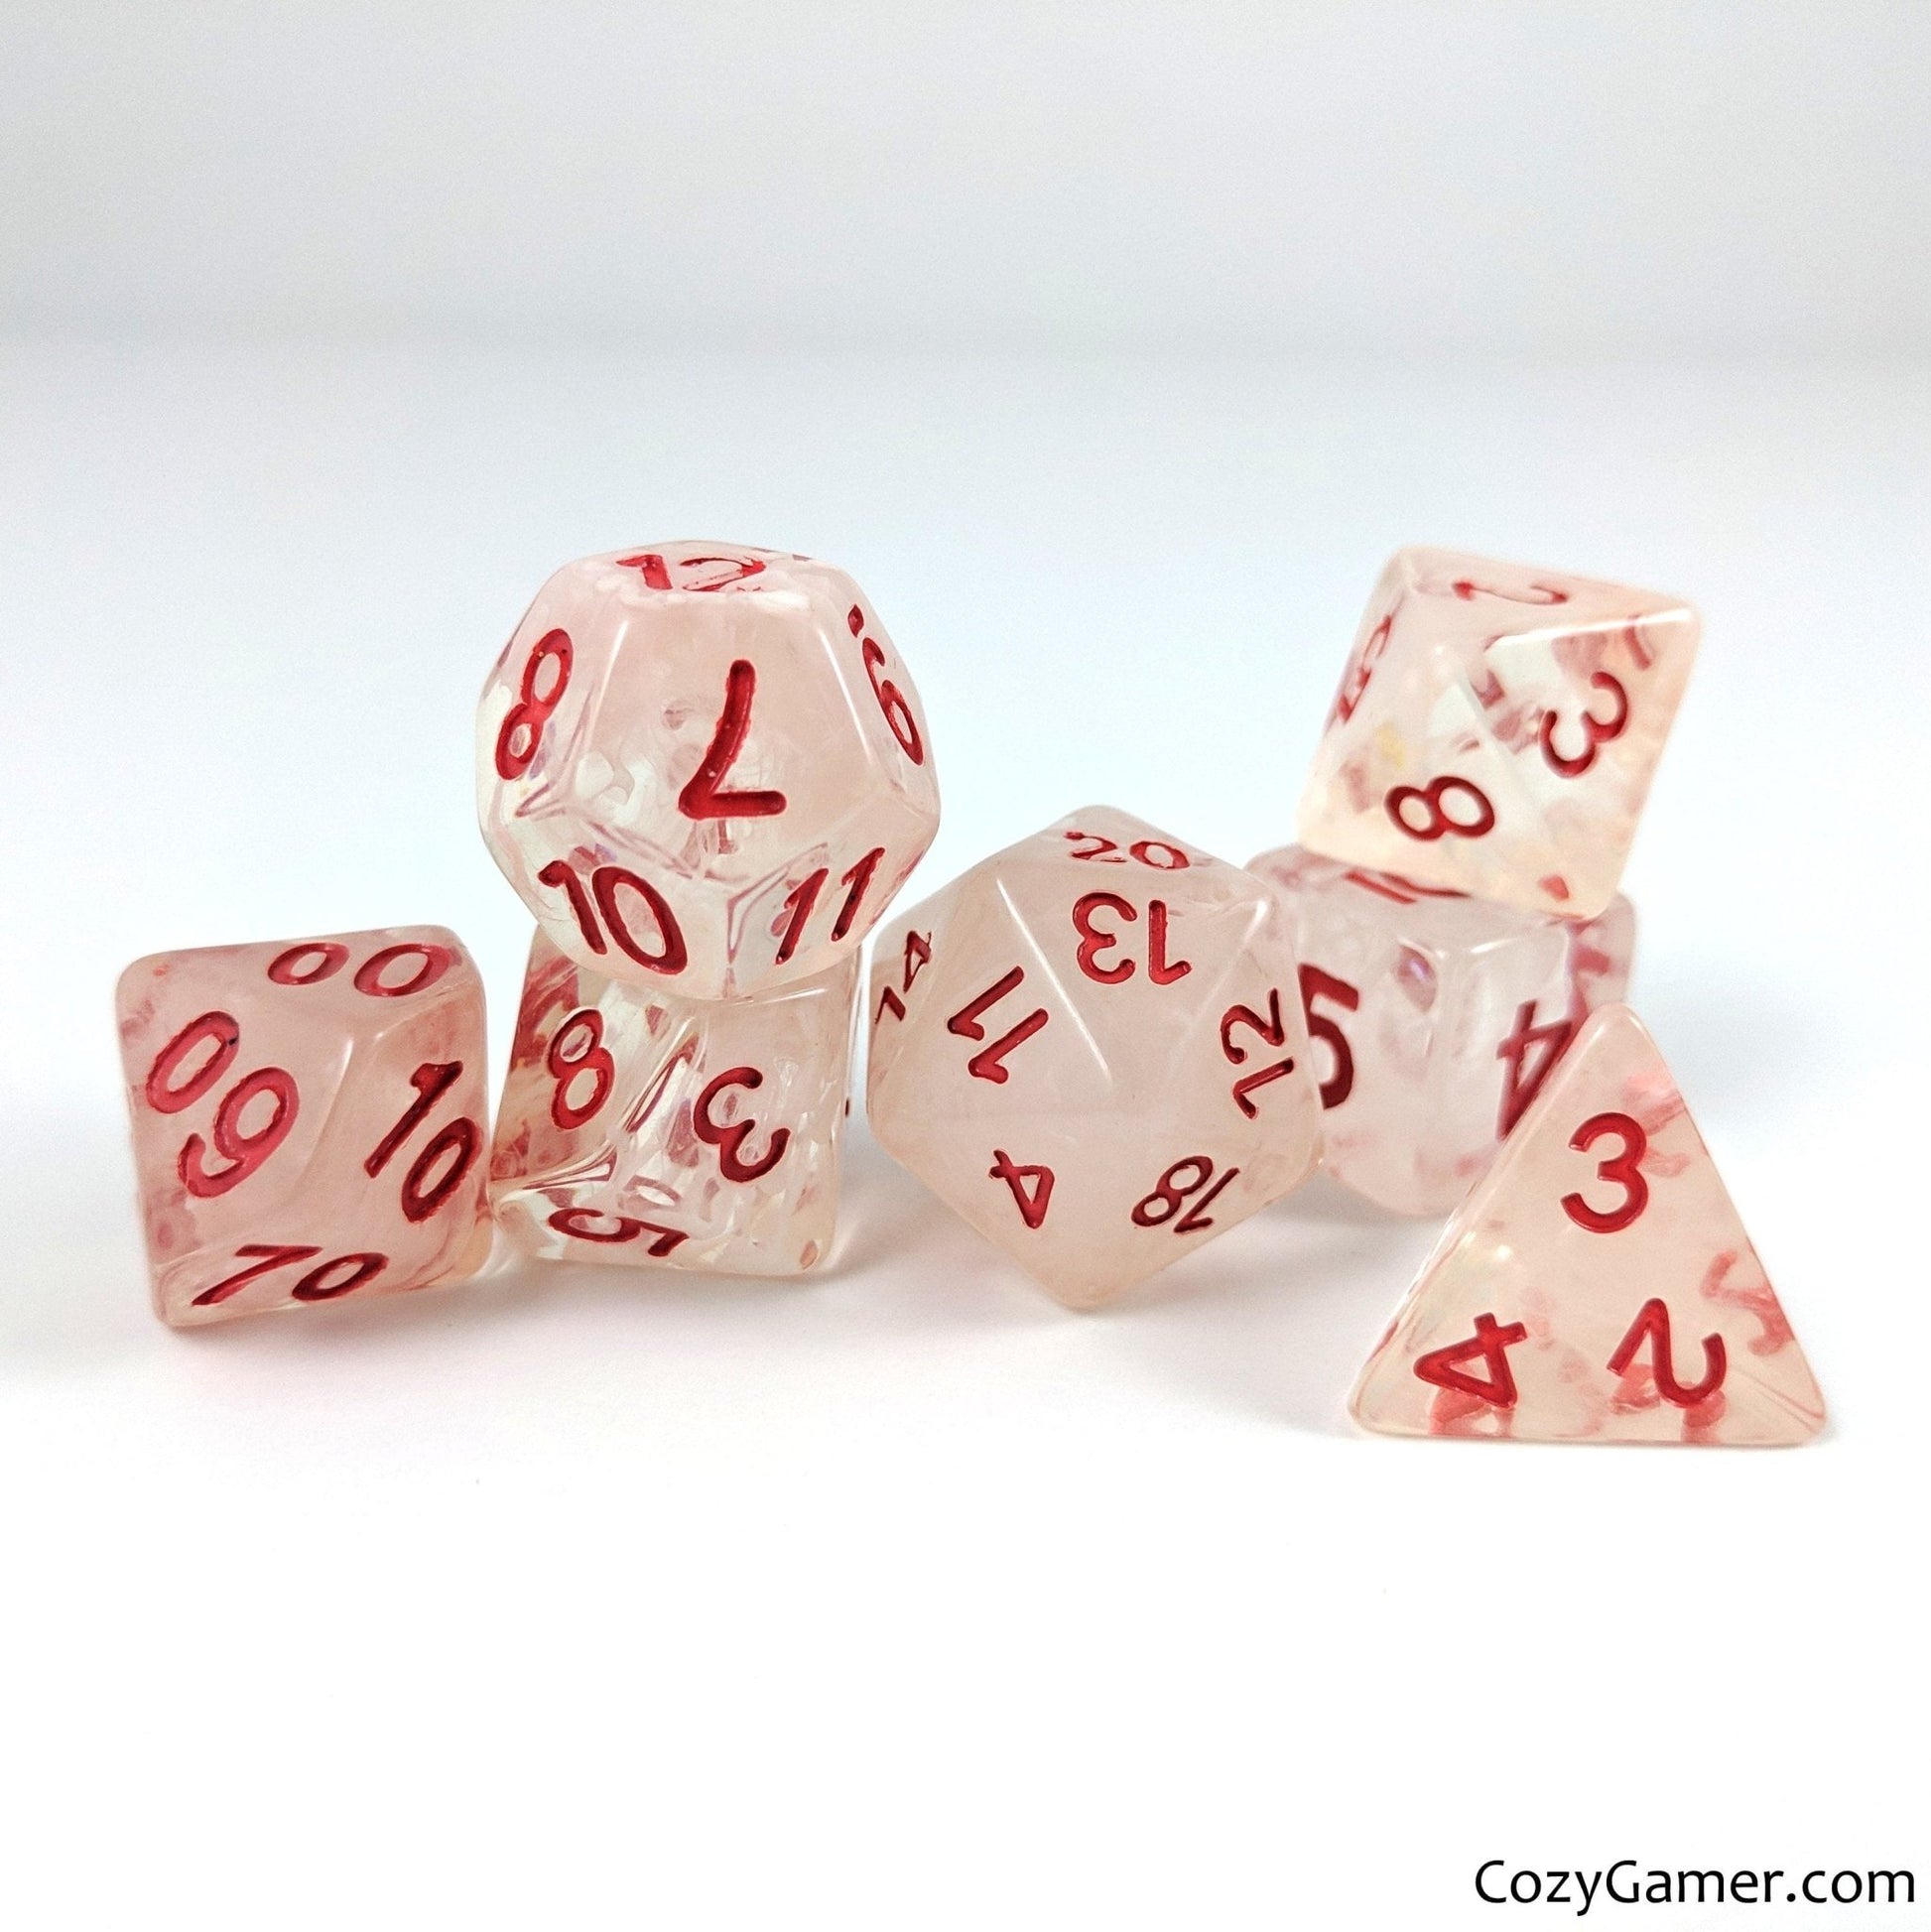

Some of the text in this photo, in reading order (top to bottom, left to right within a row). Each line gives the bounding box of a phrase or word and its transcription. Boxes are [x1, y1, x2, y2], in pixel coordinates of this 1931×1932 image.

[615, 553, 767, 592] 12
[495, 627, 575, 780] 8
[678, 659, 787, 821] 7
[1539, 671, 1628, 778] 3
[1064, 832, 1190, 870] 20
[1385, 776, 1495, 841] 8
[538, 859, 688, 975] 10
[772, 847, 886, 965] 11
[1072, 892, 1193, 985] 13
[267, 942, 456, 997] 00
[947, 966, 1049, 1085] 11
[548, 1009, 615, 1130] 8
[1220, 988, 1296, 1120] 12
[1298, 964, 1360, 1110] 5
[1496, 1000, 1580, 1141] 4
[363, 1061, 483, 1224] 10
[694, 1067, 791, 1184] 3
[1560, 1111, 1649, 1234] 3
[548, 1208, 690, 1257] 5
[989, 1150, 1056, 1230] 4
[1130, 1156, 1241, 1234] 18
[192, 1244, 390, 1307] 70
[1413, 1313, 1529, 1409] 4
[1607, 1298, 1729, 1409] 2
